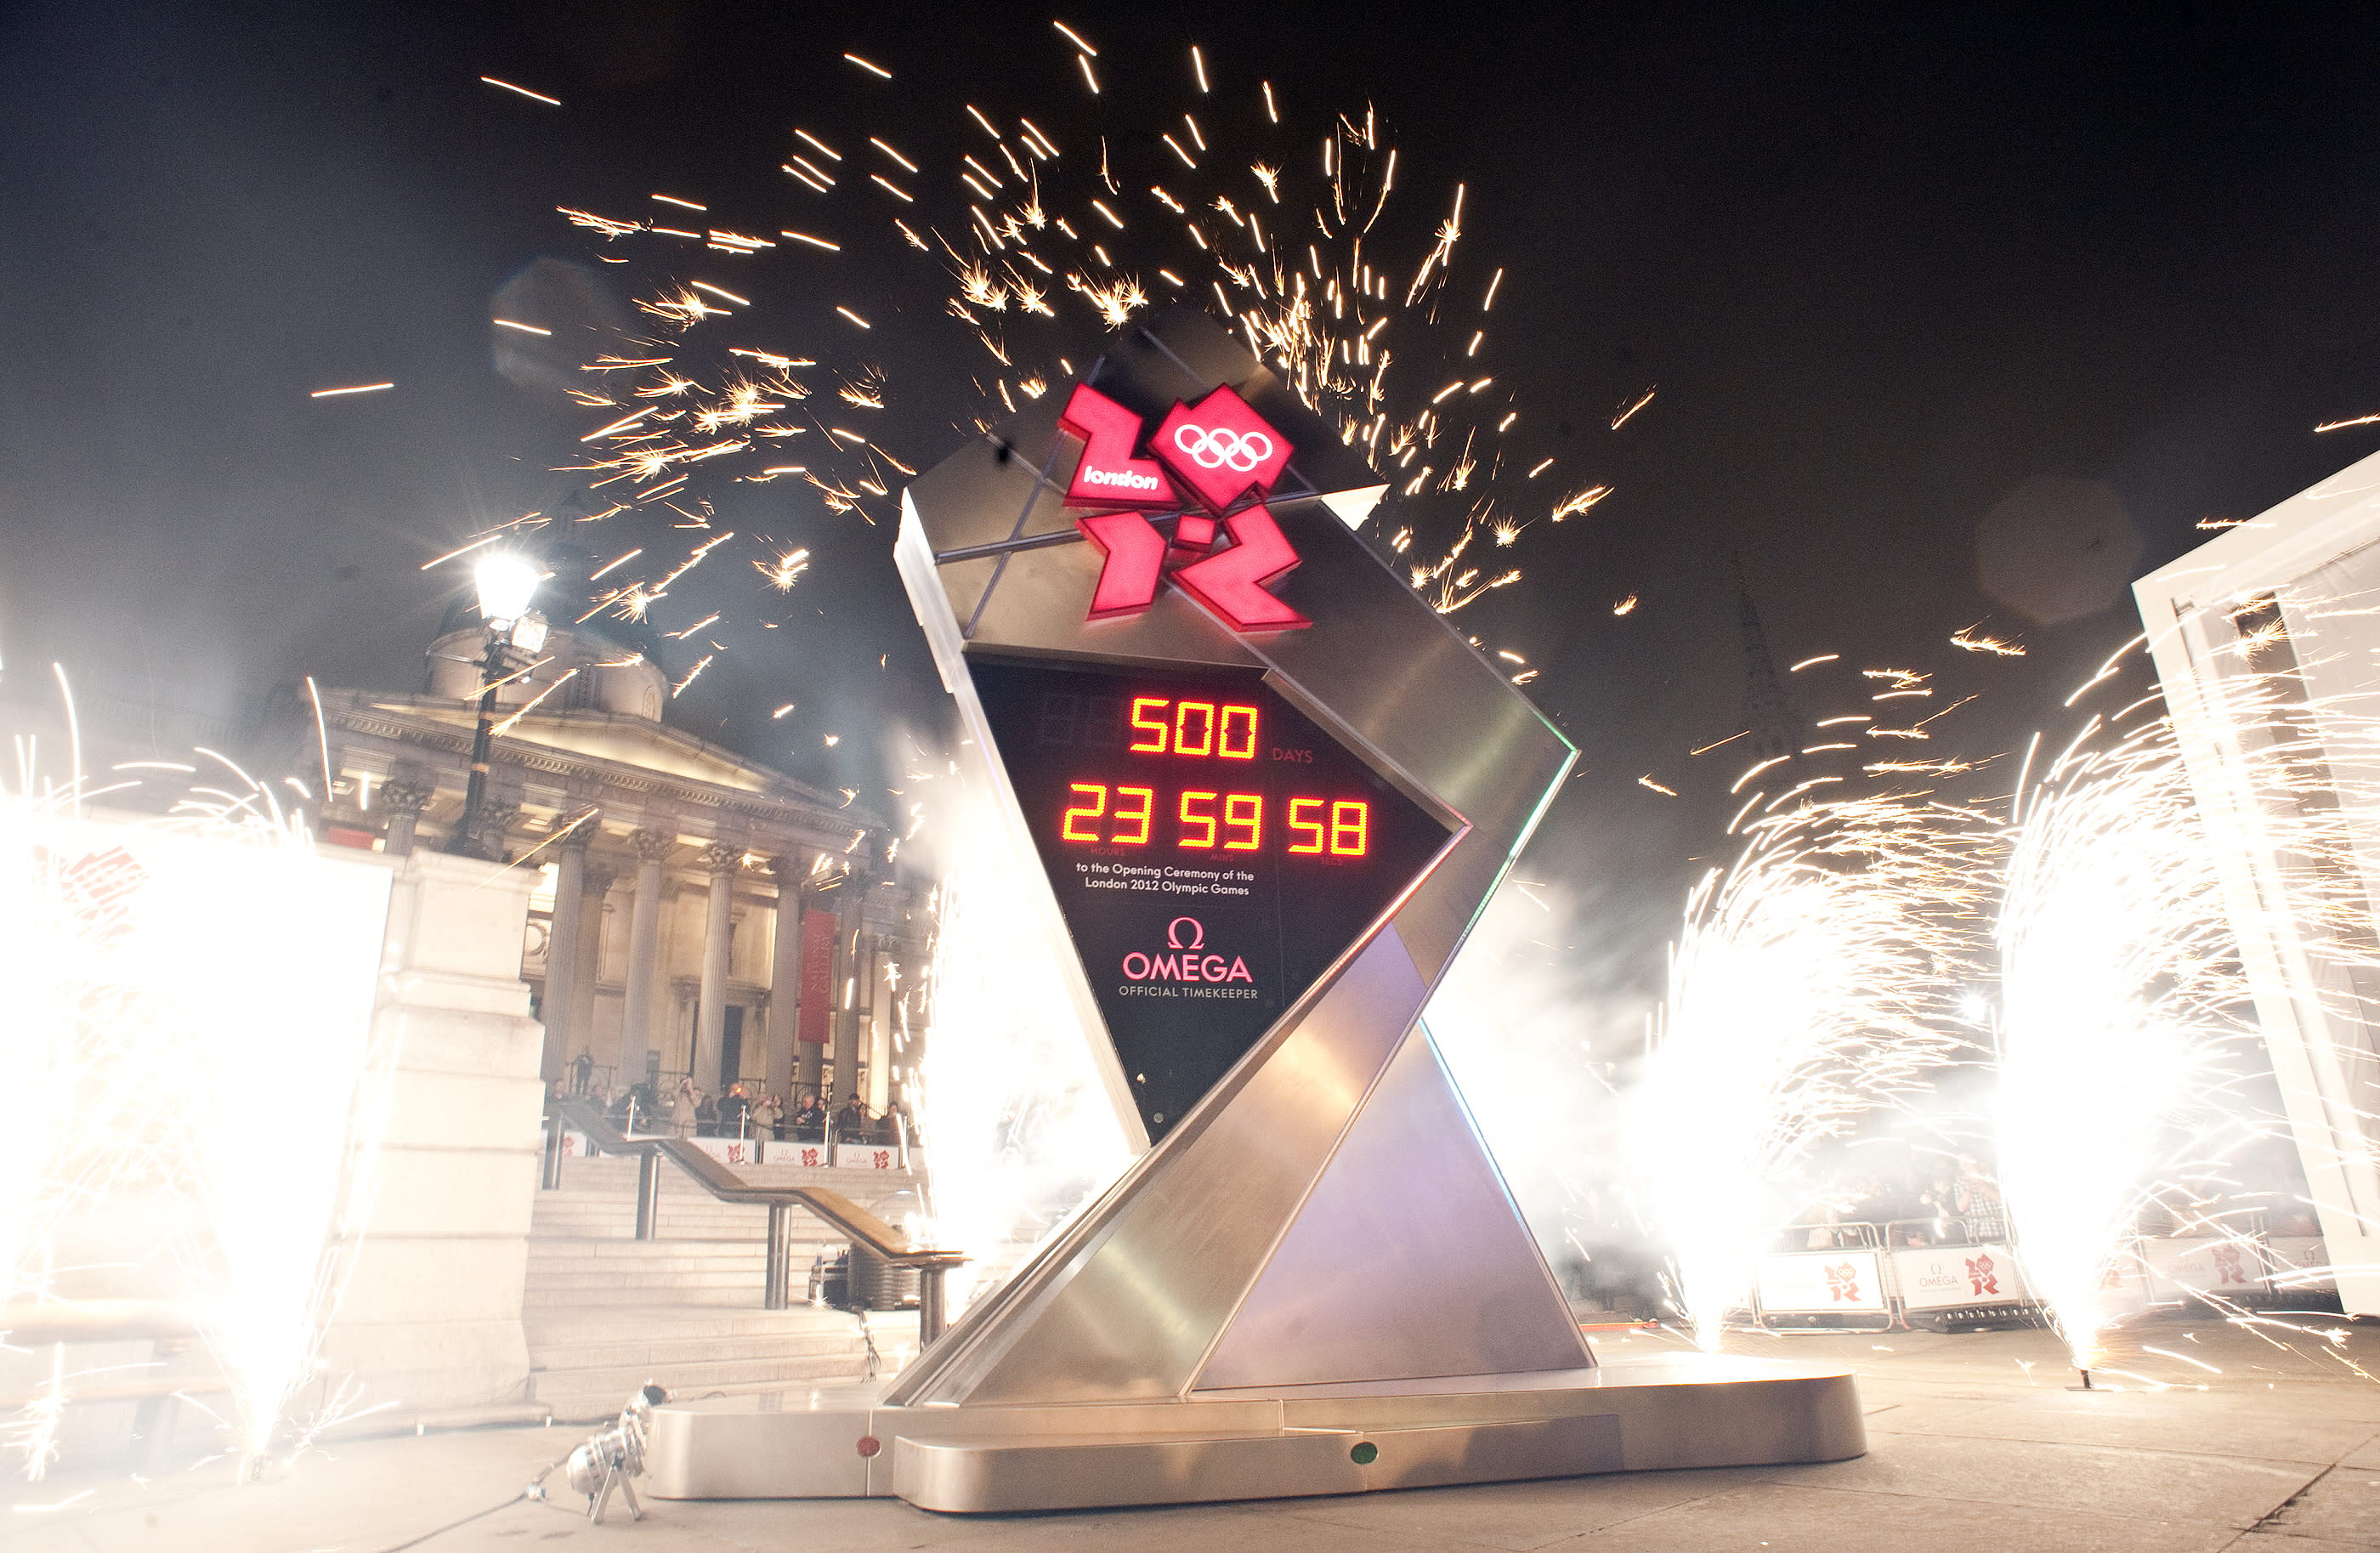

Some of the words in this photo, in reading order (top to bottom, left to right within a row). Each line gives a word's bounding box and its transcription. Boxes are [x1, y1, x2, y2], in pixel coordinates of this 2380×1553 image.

[1083, 465, 1159, 490] london
[1129, 697, 1259, 760] 500
[1272, 747, 1313, 763] DAYS
[1062, 782, 1153, 844] 23
[1178, 790, 1264, 850] 59
[1288, 797, 1368, 856] 58
[1091, 846, 1125, 857] HOURS
[1076, 862, 1088, 872] to
[1091, 862, 1110, 874] the
[1112, 864, 1162, 878] Opening
[1164, 866, 1220, 881] Ceremony
[1222, 870, 1234, 881] of
[1236, 870, 1255, 881] the
[1085, 876, 1128, 889] London
[1130, 879, 1159, 892] 2012
[1161, 881, 1209, 895] Olympic
[1210, 883, 1250, 896] Games
[1122, 951, 1254, 983] OMEGA
[1119, 985, 1179, 997] OFFICIAL
[1182, 987, 1258, 1000] TIMEKEEPER
[1919, 1275, 1958, 1287] OMEGA
